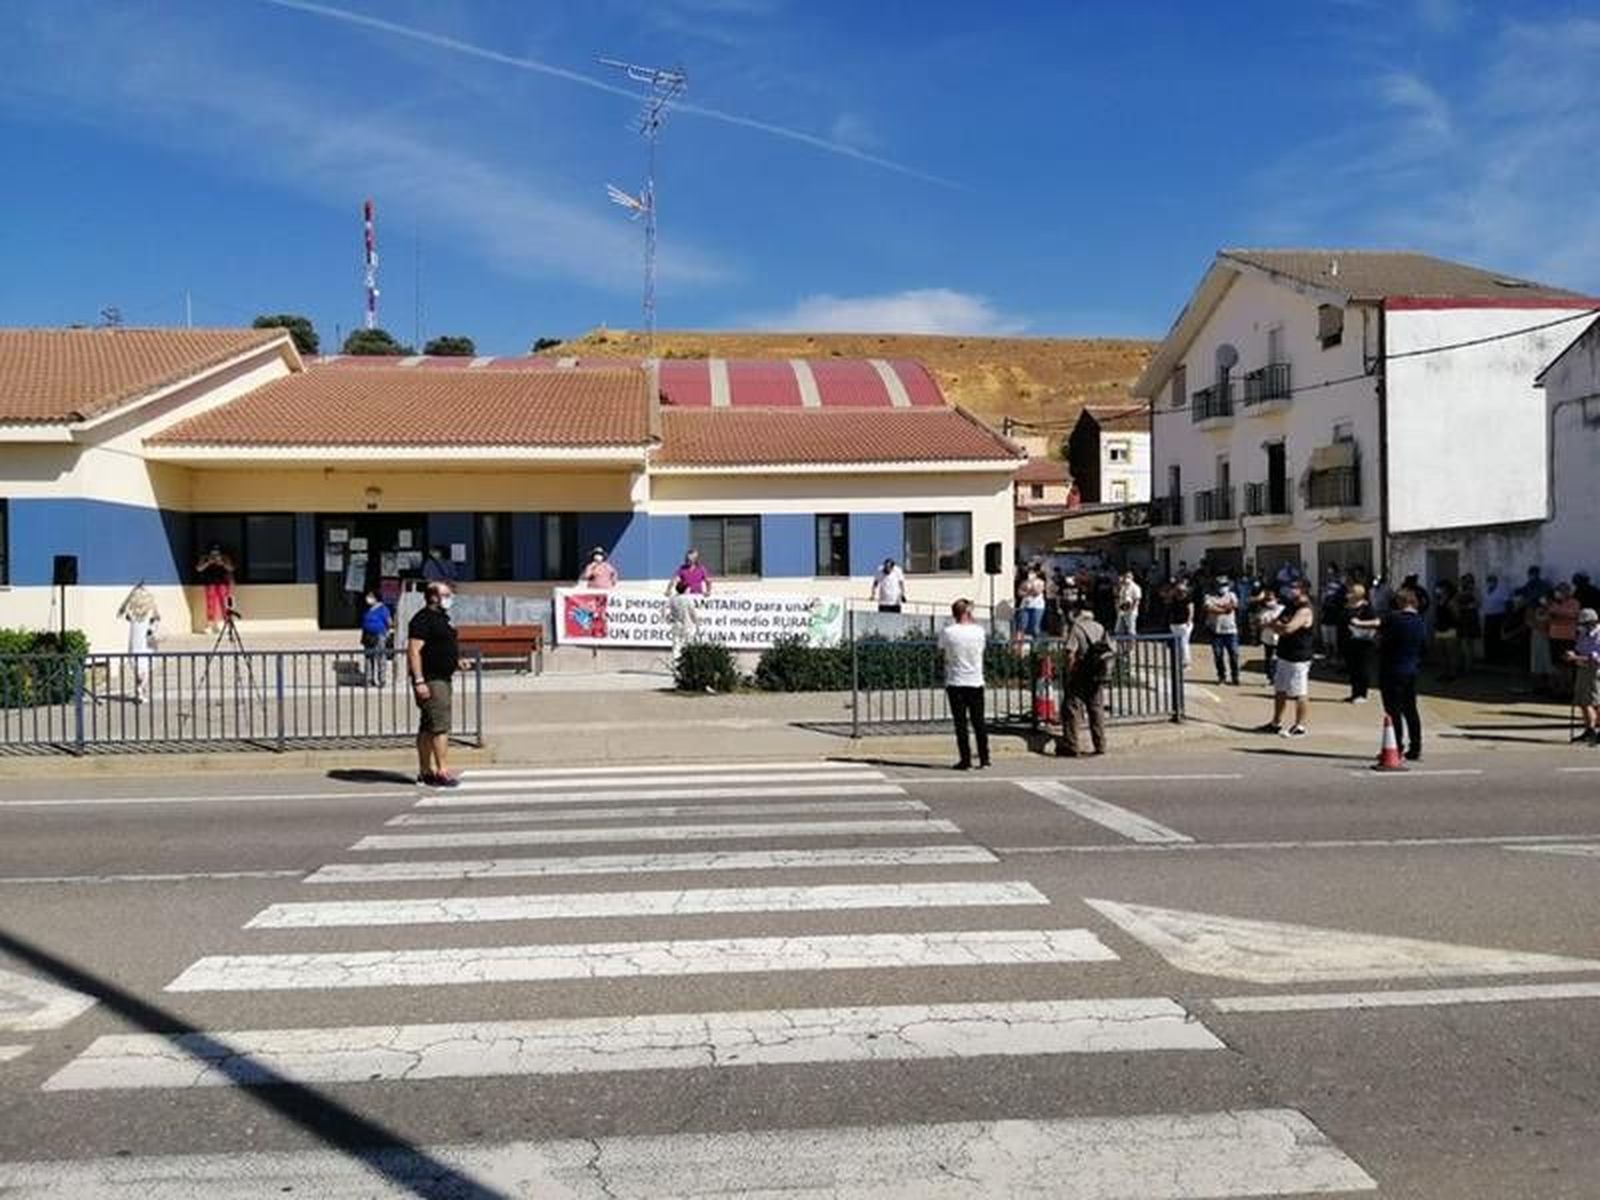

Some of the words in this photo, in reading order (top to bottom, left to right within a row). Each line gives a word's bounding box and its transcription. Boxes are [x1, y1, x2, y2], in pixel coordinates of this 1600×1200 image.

[755, 602, 782, 613] para
[785, 602, 809, 612] una
[715, 616, 727, 627] el
[730, 617, 769, 628] medio
[773, 617, 814, 628] RURAL
[610, 629, 629, 640] UN
[633, 629, 673, 641] DEREC
[709, 632, 737, 643] UNA
[741, 632, 811, 644] NECESIDAD
